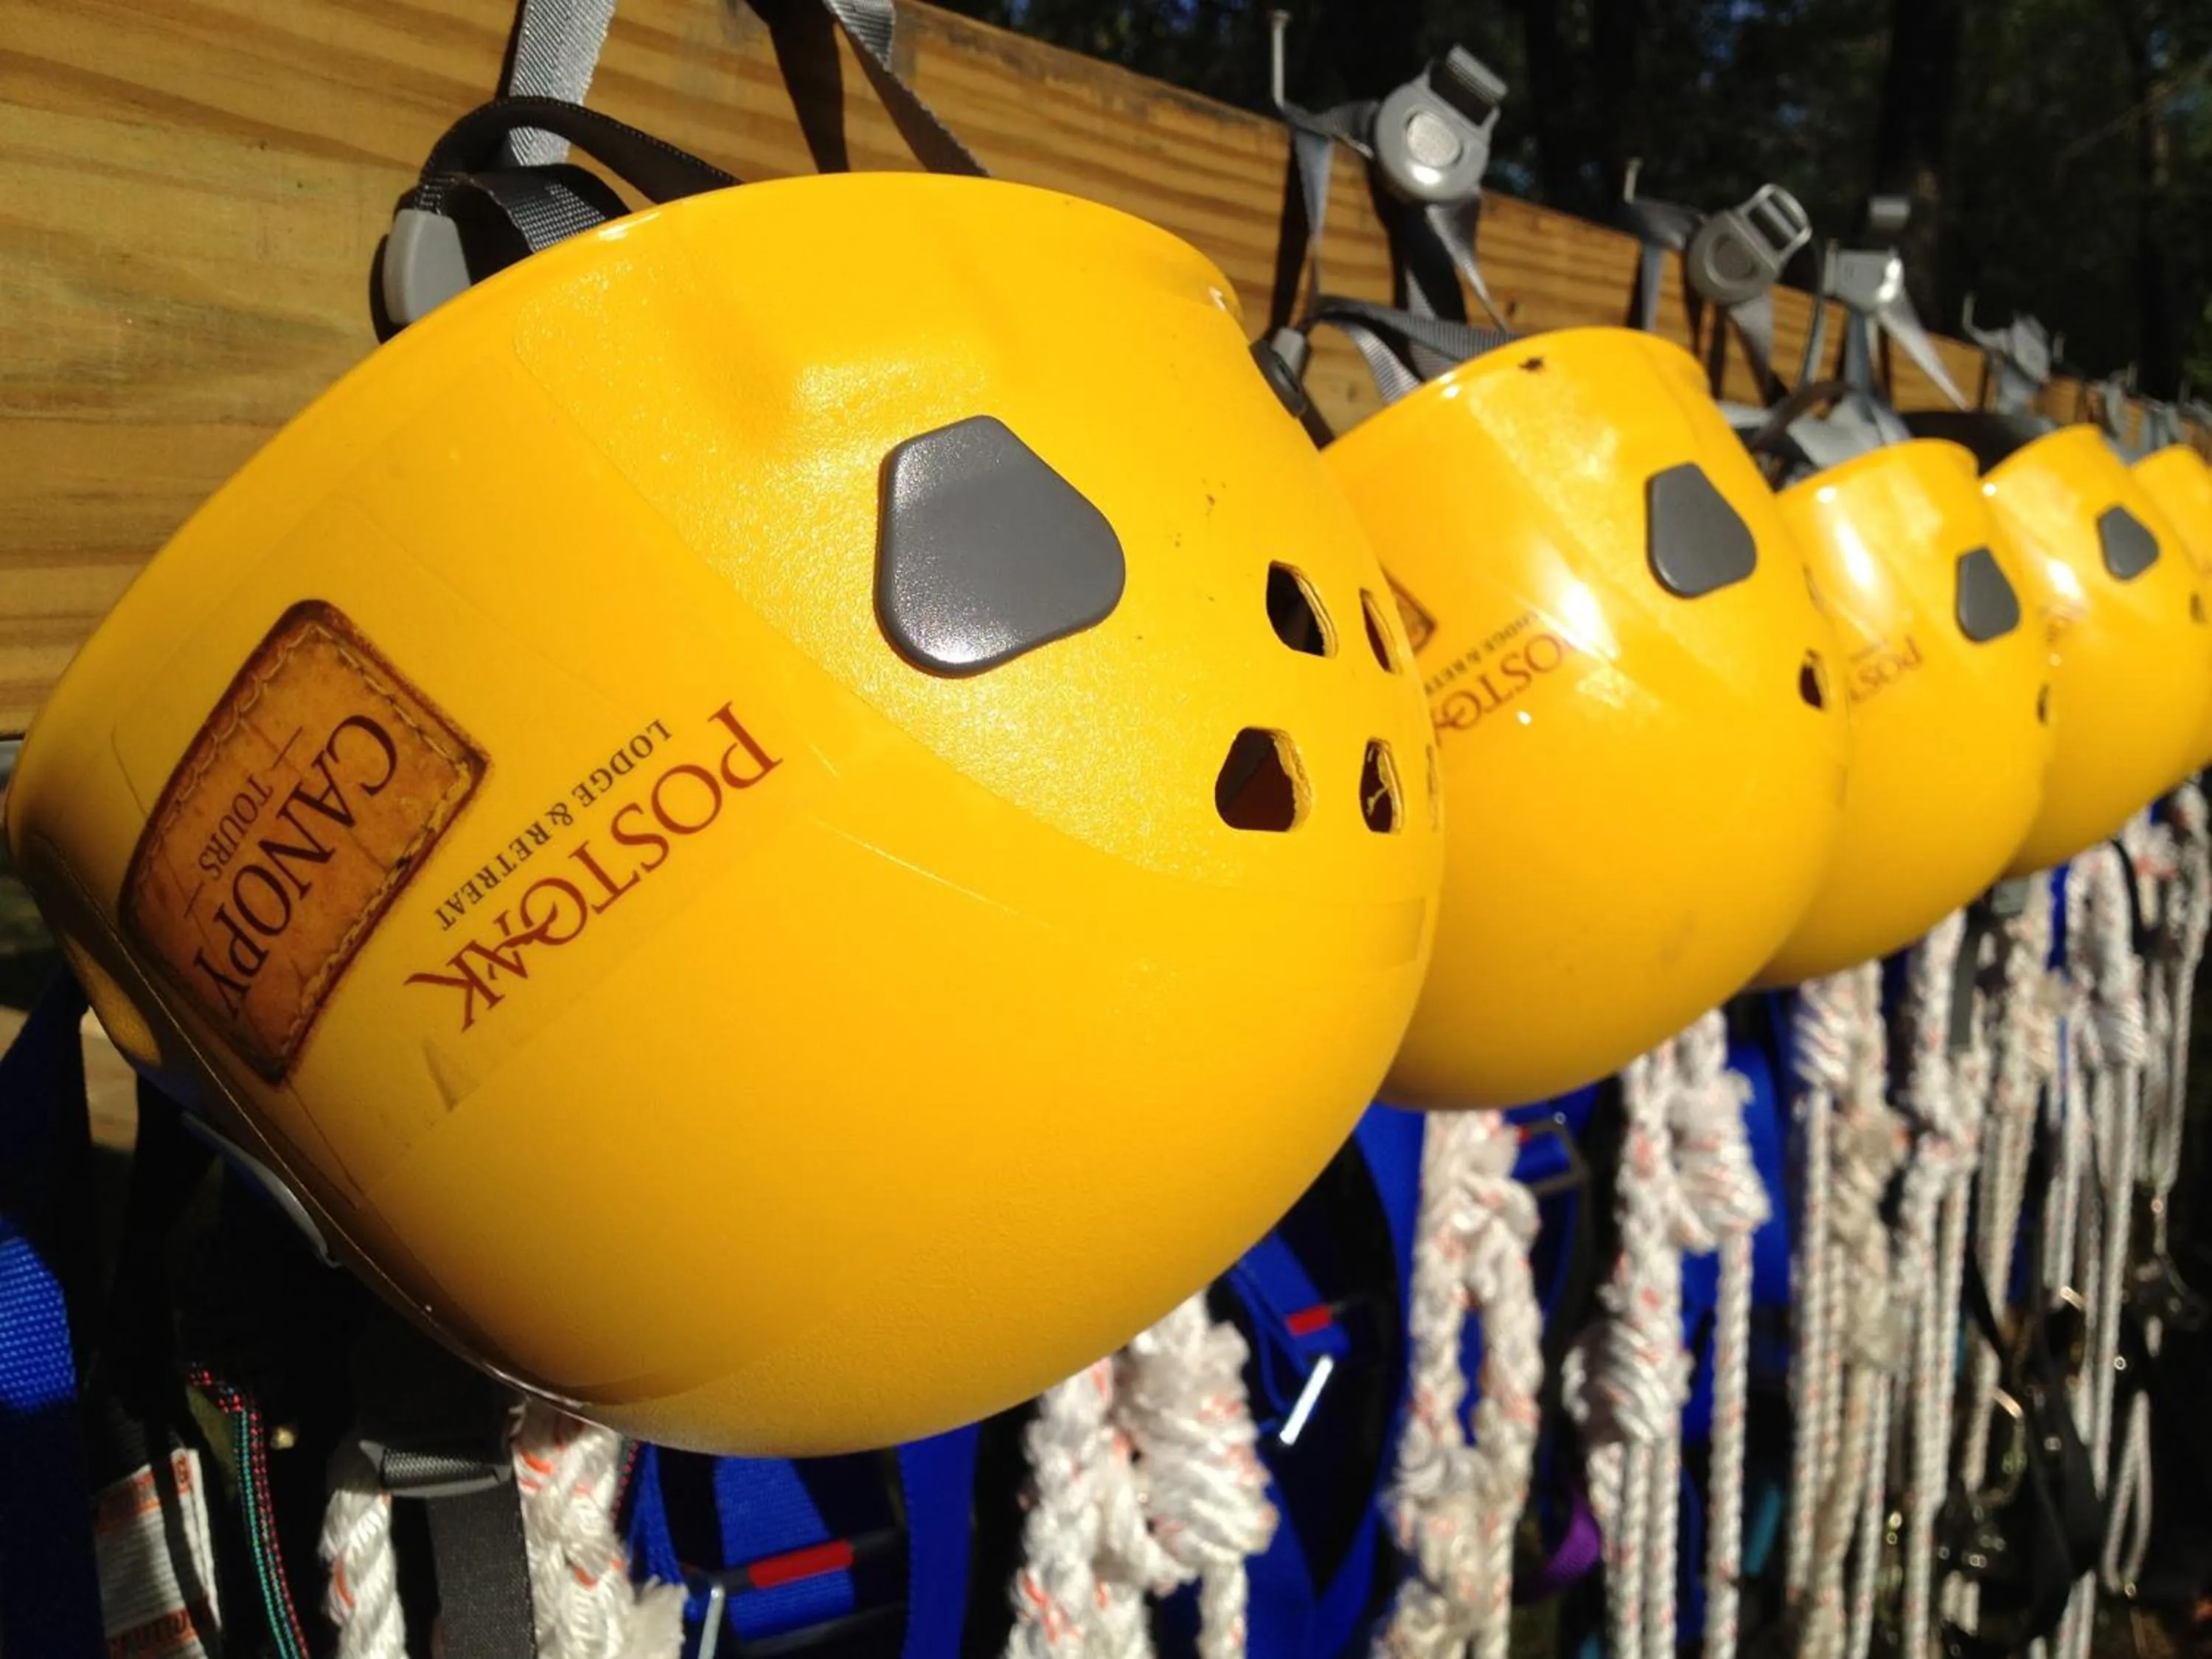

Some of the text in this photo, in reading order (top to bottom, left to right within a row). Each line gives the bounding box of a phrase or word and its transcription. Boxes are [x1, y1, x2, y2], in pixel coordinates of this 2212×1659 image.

[192, 714, 399, 1020] CANOPY
[197, 773, 274, 881] TOURS
[435, 719, 672, 932] LODGE & RETREAT
